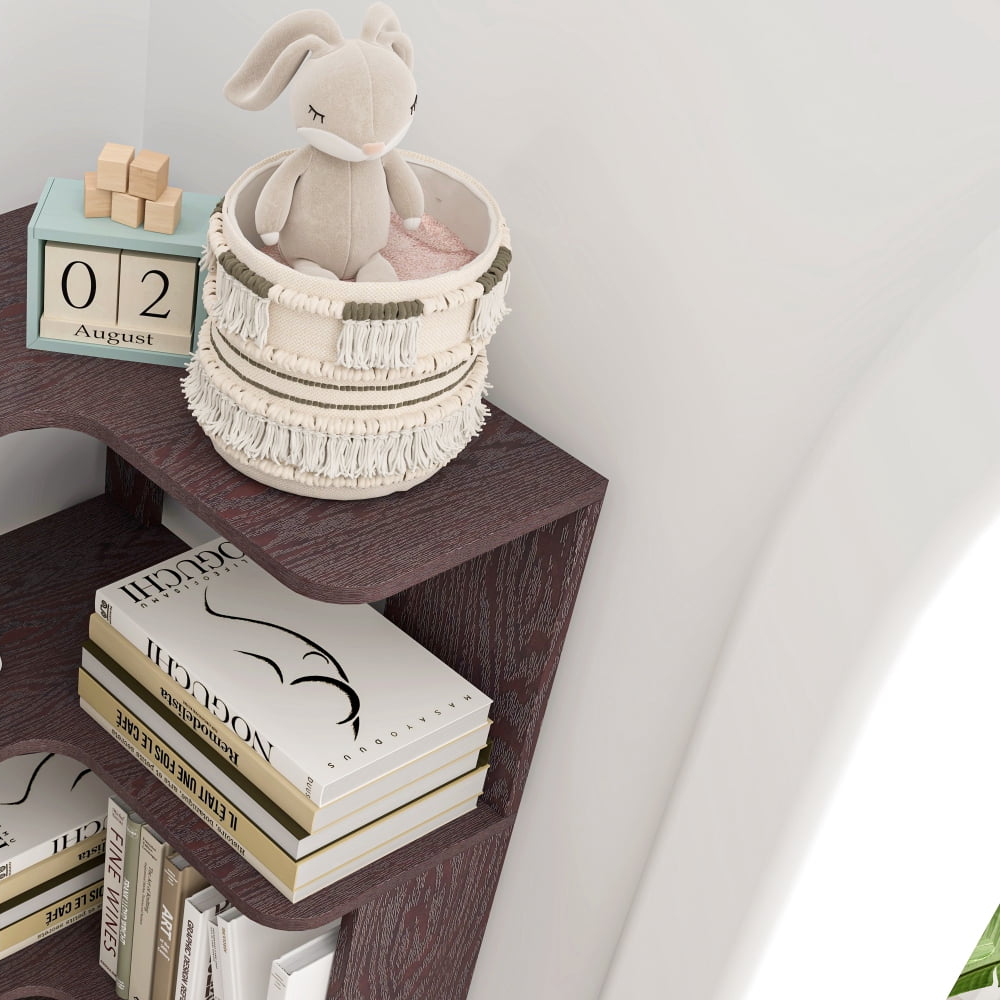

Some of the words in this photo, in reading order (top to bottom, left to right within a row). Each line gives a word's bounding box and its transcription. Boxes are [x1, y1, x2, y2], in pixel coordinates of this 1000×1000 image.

[75, 324, 154, 346] August
[118, 541, 245, 604] OGUCHI
[147, 637, 275, 764] NOGUCHI
[115, 709, 140, 742] CAFÉ
[160, 687, 240, 767] Remodelista
[142, 733, 153, 754] LE
[154, 745, 176, 774] FOIS
[178, 766, 197, 794] UNE
[199, 786, 227, 821] ÉTAIT
[229, 816, 238, 832] IL
[107, 826, 124, 884] FINE
[75, 894, 88, 909] LE
[103, 888, 121, 959] WINES
[160, 903, 174, 942] ART
